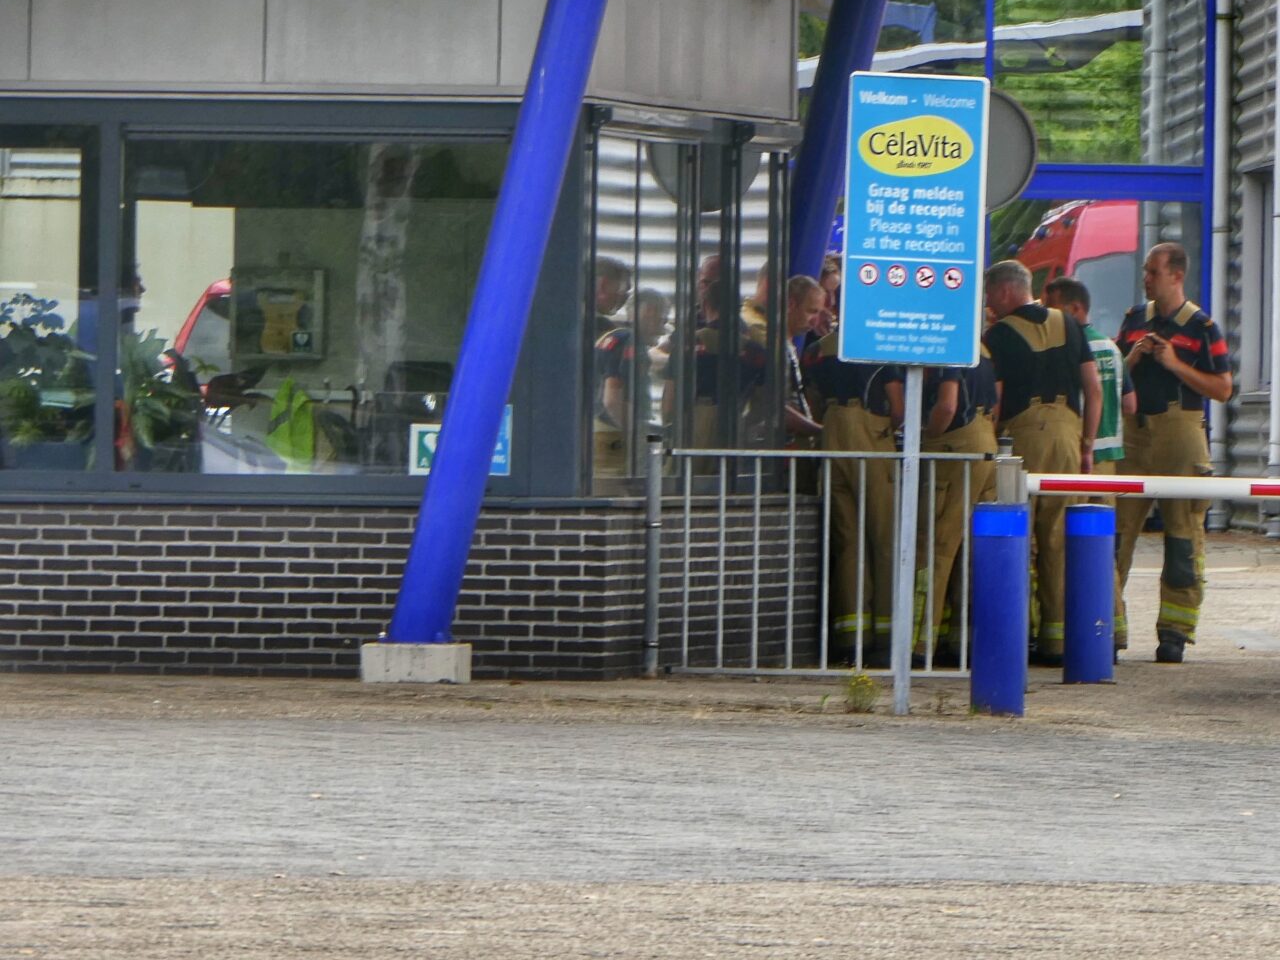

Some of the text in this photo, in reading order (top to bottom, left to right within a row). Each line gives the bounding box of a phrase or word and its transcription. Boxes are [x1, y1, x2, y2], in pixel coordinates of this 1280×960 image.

[859, 90, 908, 106] Welkom
[923, 93, 976, 109] Welcome
[869, 184, 964, 201] Graag melden
[867, 200, 965, 220] bij de receptie
[870, 219, 959, 238] Please sign in
[863, 236, 965, 254] at the reception
